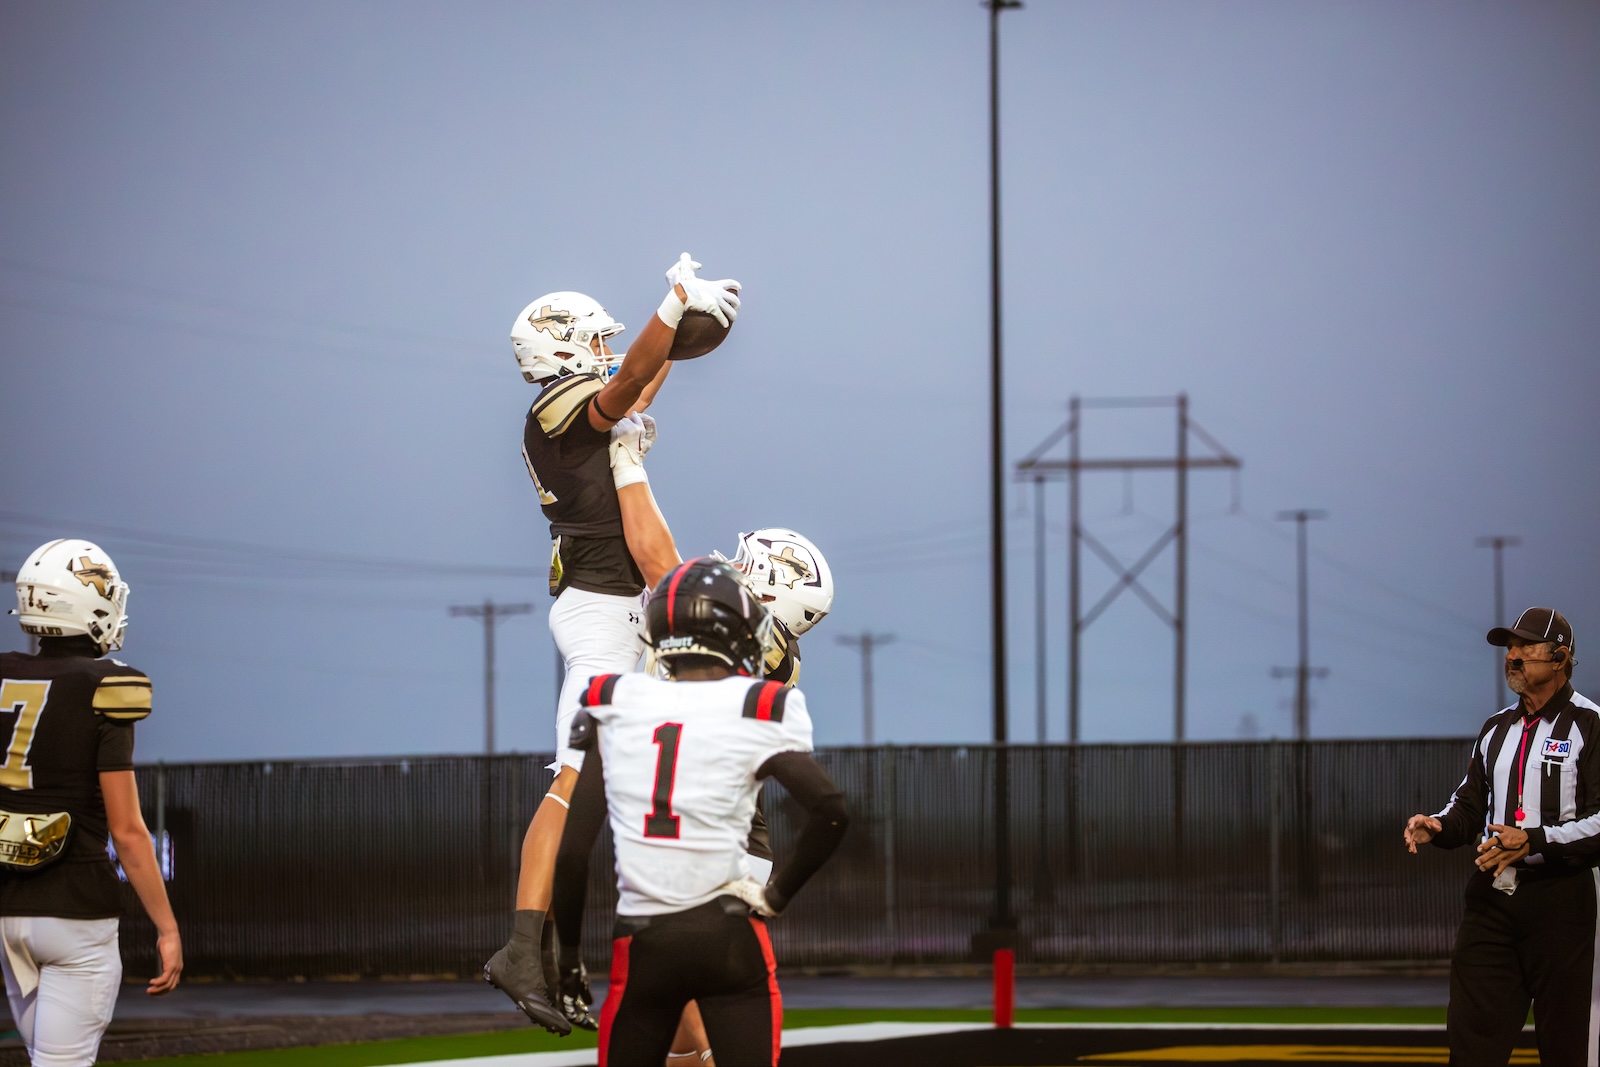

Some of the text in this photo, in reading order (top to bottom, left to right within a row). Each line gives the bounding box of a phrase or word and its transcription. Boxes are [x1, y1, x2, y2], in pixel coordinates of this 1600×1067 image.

[1557, 633, 1564, 642] S
[0, 678, 52, 790] 7
[643, 722, 683, 840] 1
